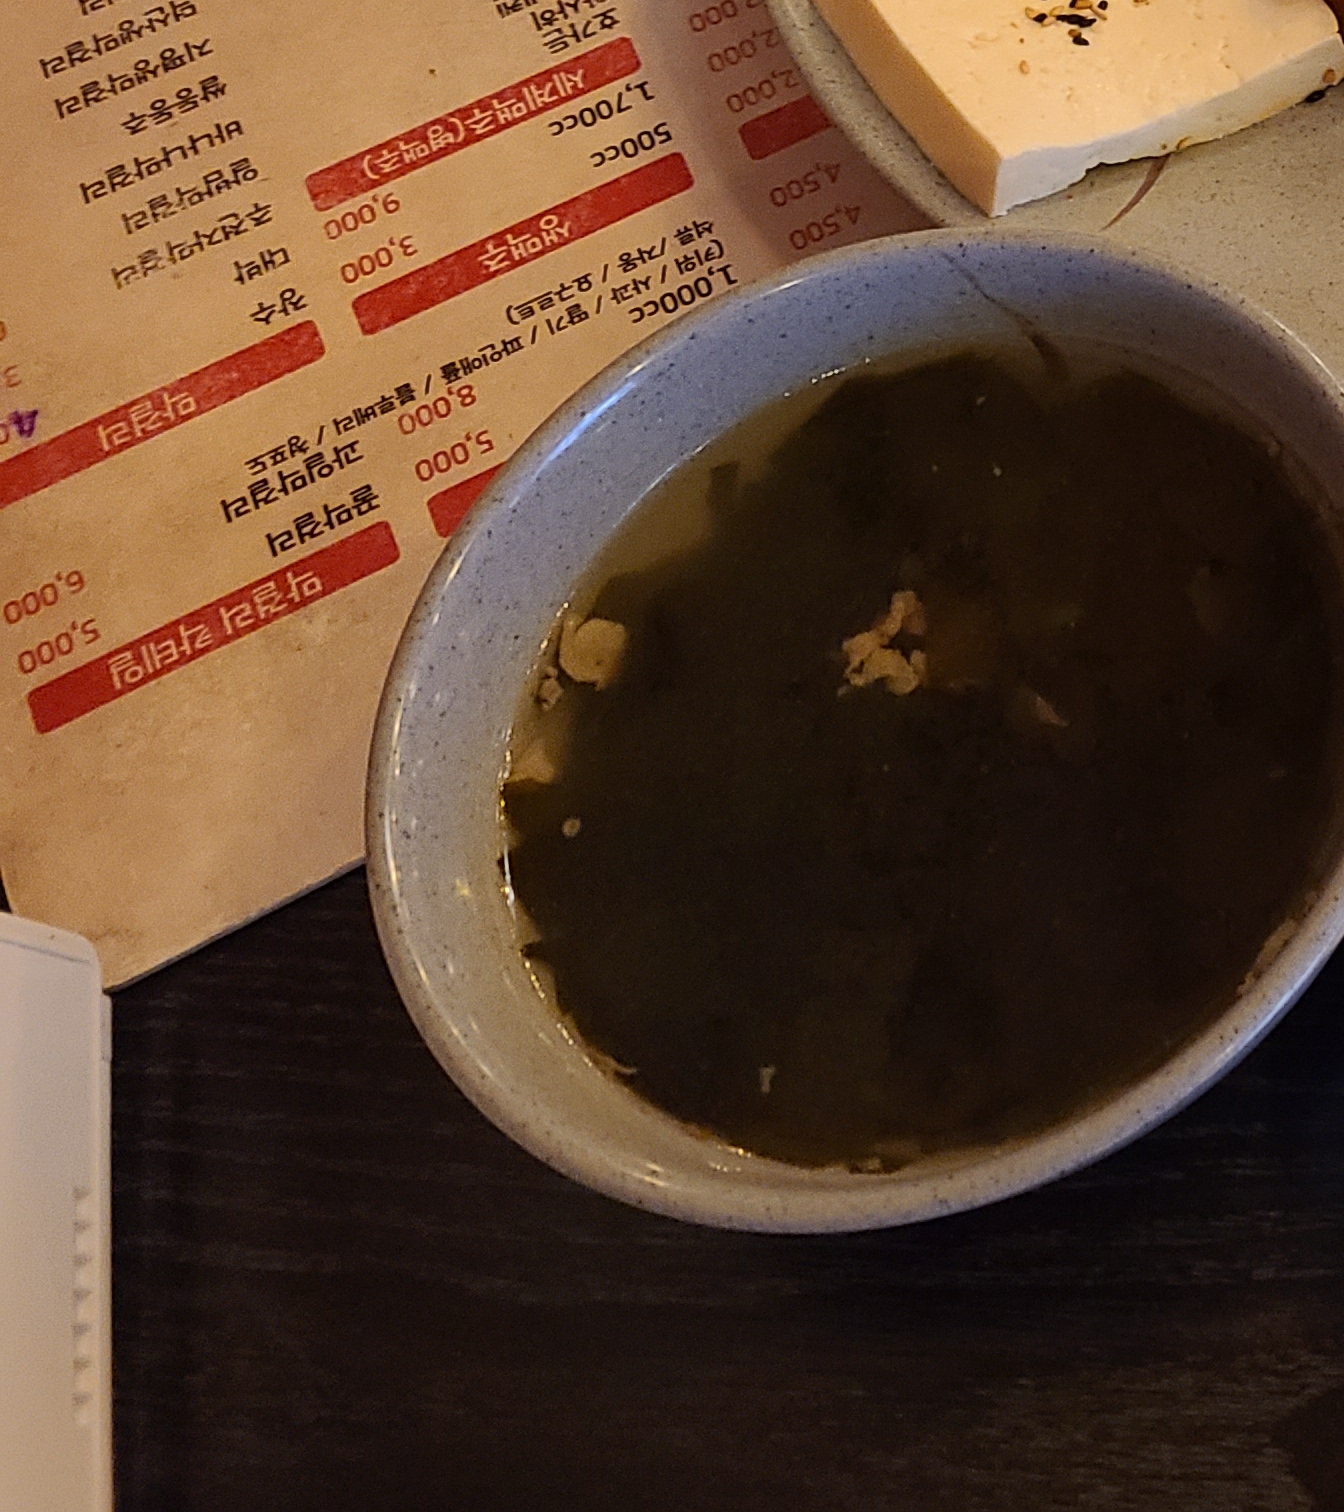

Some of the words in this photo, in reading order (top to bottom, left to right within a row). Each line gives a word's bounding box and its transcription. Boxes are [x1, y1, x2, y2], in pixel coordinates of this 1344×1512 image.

[38, 0, 197, 79] 덕산생막걸리
[542, 6, 620, 55] 호가든
[707, 29, 780, 72] 2,000
[53, 38, 214, 120] 지평생막걸리
[119, 75, 228, 136] 쌀동동주
[726, 69, 799, 113] 2,000
[361, 68, 586, 181] 세계맥주(병맥주)
[547, 79, 656, 138] 1,700cc
[79, 119, 244, 205] 바나나막걸리
[588, 121, 674, 169] 500cc
[120, 157, 259, 235] 알밤막걸리
[769, 162, 841, 208] 4,500
[322, 192, 401, 241] 9,000
[672, 219, 714, 247] 석류
[789, 205, 862, 251] 4,500
[110, 201, 274, 290] 주전자막걸리
[232, 247, 291, 285] 대박
[338, 234, 419, 285] 3,000
[476, 214, 572, 274] 생맥주
[673, 239, 724, 276] (키위
[249, 287, 309, 326] 장수
[504, 271, 593, 327] 요구르트)
[609, 275, 652, 306] 사과
[627, 263, 738, 324] 1,000cc
[544, 304, 590, 336] 딸기
[439, 335, 525, 385] 파인애플
[95, 389, 197, 452] 막걸리
[331, 382, 416, 436] 블루베리
[397, 383, 477, 435] 8,000
[219, 439, 365, 523] 과일막걸리
[243, 434, 310, 476] 청포도
[414, 429, 495, 482] 5,000
[264, 483, 380, 558] 꿀막걸리
[2, 570, 86, 625] 6,000
[219, 571, 322, 635] 막걸리
[17, 617, 101, 675] 5,000
[107, 623, 213, 690] 칵테일
